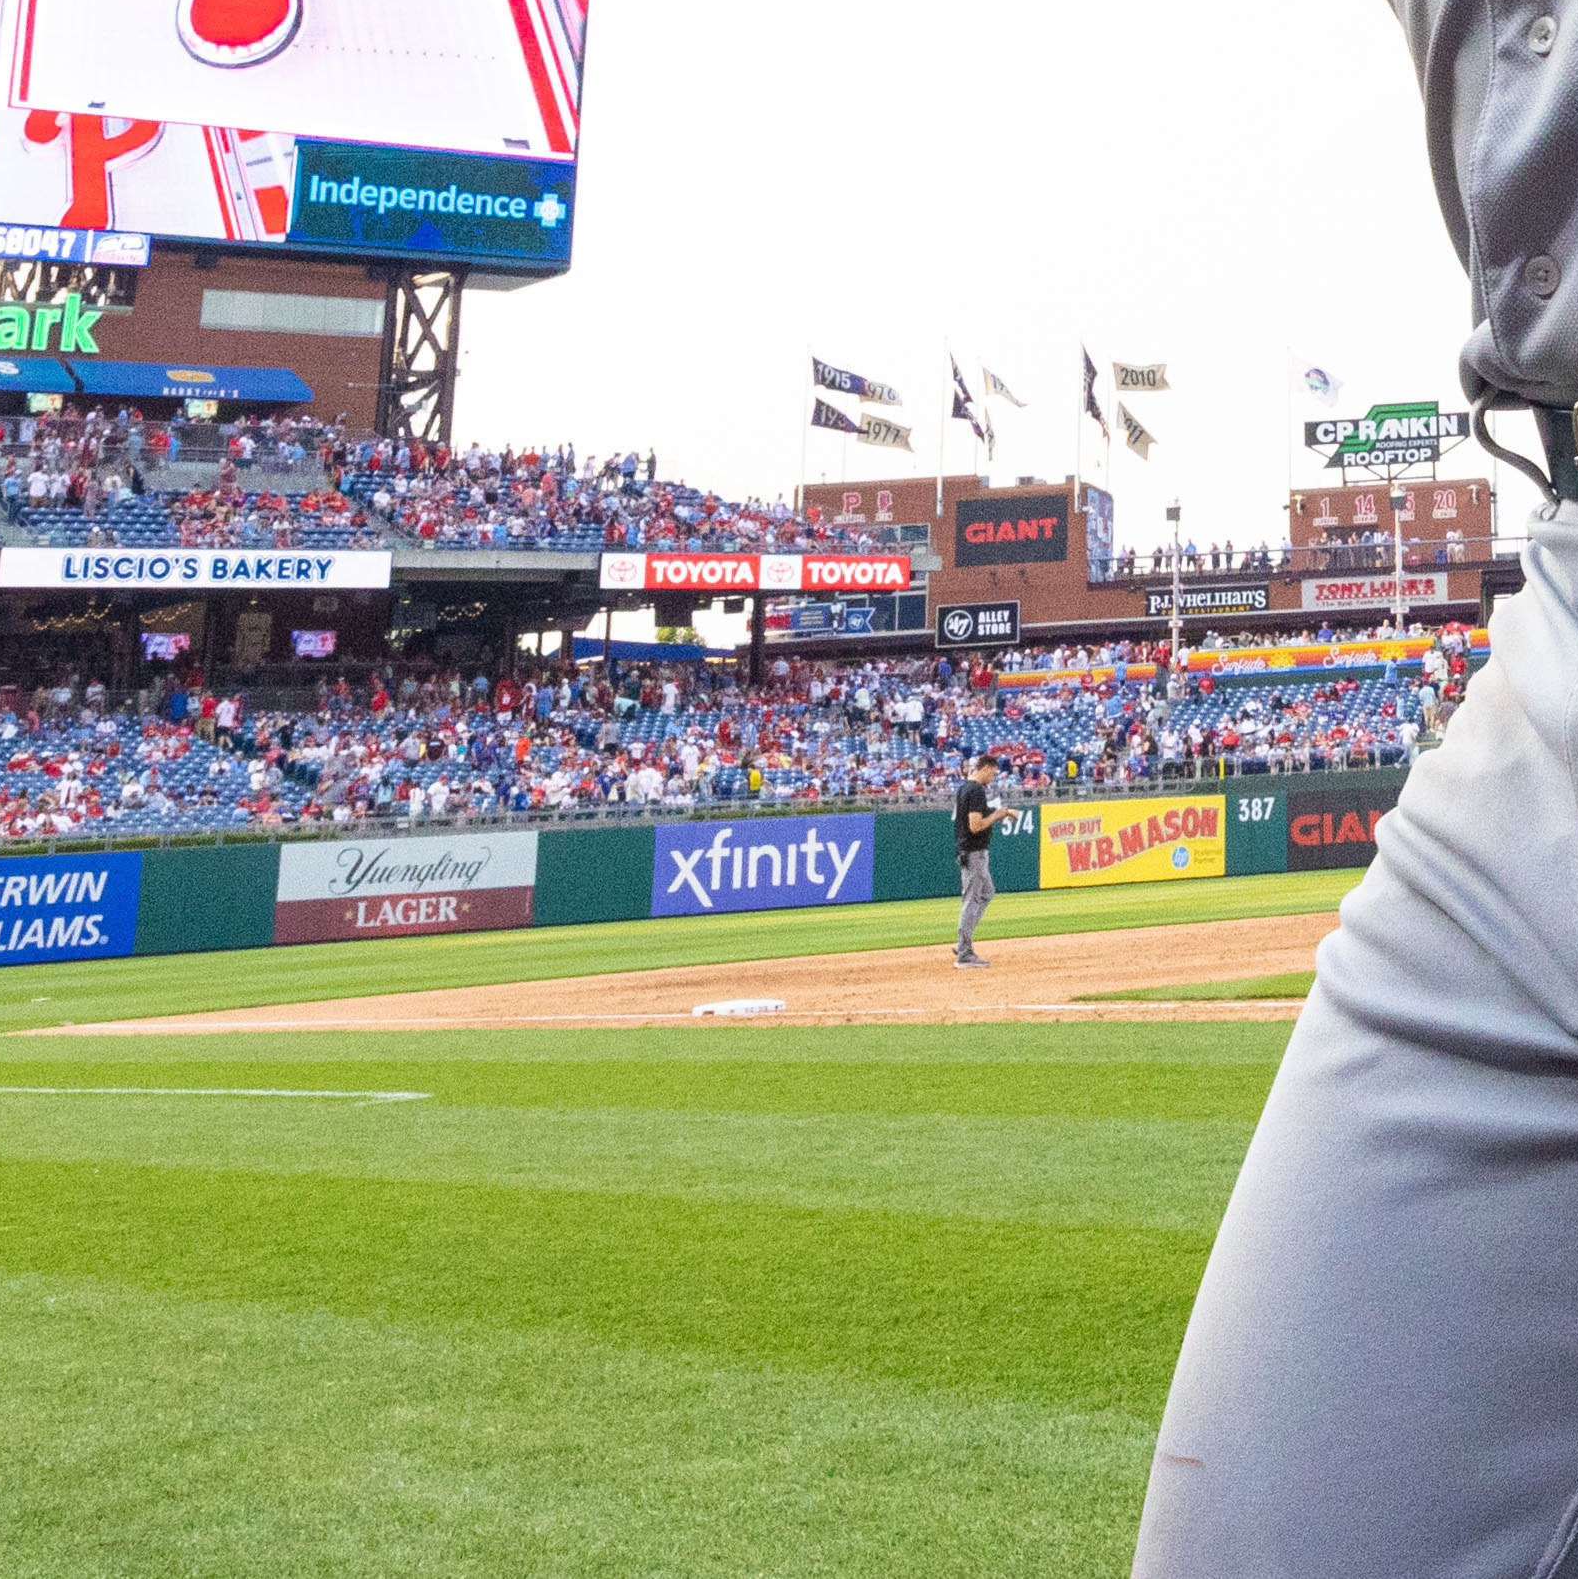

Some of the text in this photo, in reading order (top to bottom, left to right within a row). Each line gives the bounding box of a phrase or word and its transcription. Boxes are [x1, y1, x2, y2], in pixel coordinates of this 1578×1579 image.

[309, 174, 527, 222] Independence
[817, 363, 852, 390] 1915
[1120, 368, 1157, 387] 2010
[866, 420, 902, 445] 1977
[1316, 414, 1459, 443] CP RANKIN
[1343, 448, 1433, 466] ROOFTOP
[1433, 489, 1457, 510] 20
[964, 518, 1058, 544] GIANT
[62, 554, 335, 582] LISCIO'S BAKERY
[651, 560, 755, 585] TOYOTA
[807, 561, 904, 585] TOYOTA
[1315, 582, 1366, 601] TONY
[978, 610, 1010, 623] ALLEY
[978, 622, 1011, 635] STORE
[1211, 646, 1378, 675] Surfside Surfside
[1238, 797, 1274, 821] 387
[1048, 818, 1102, 839] WHO BUT
[328, 846, 491, 896] Yuengling
[667, 827, 861, 907] xfinity
[355, 896, 458, 928] LAGER
